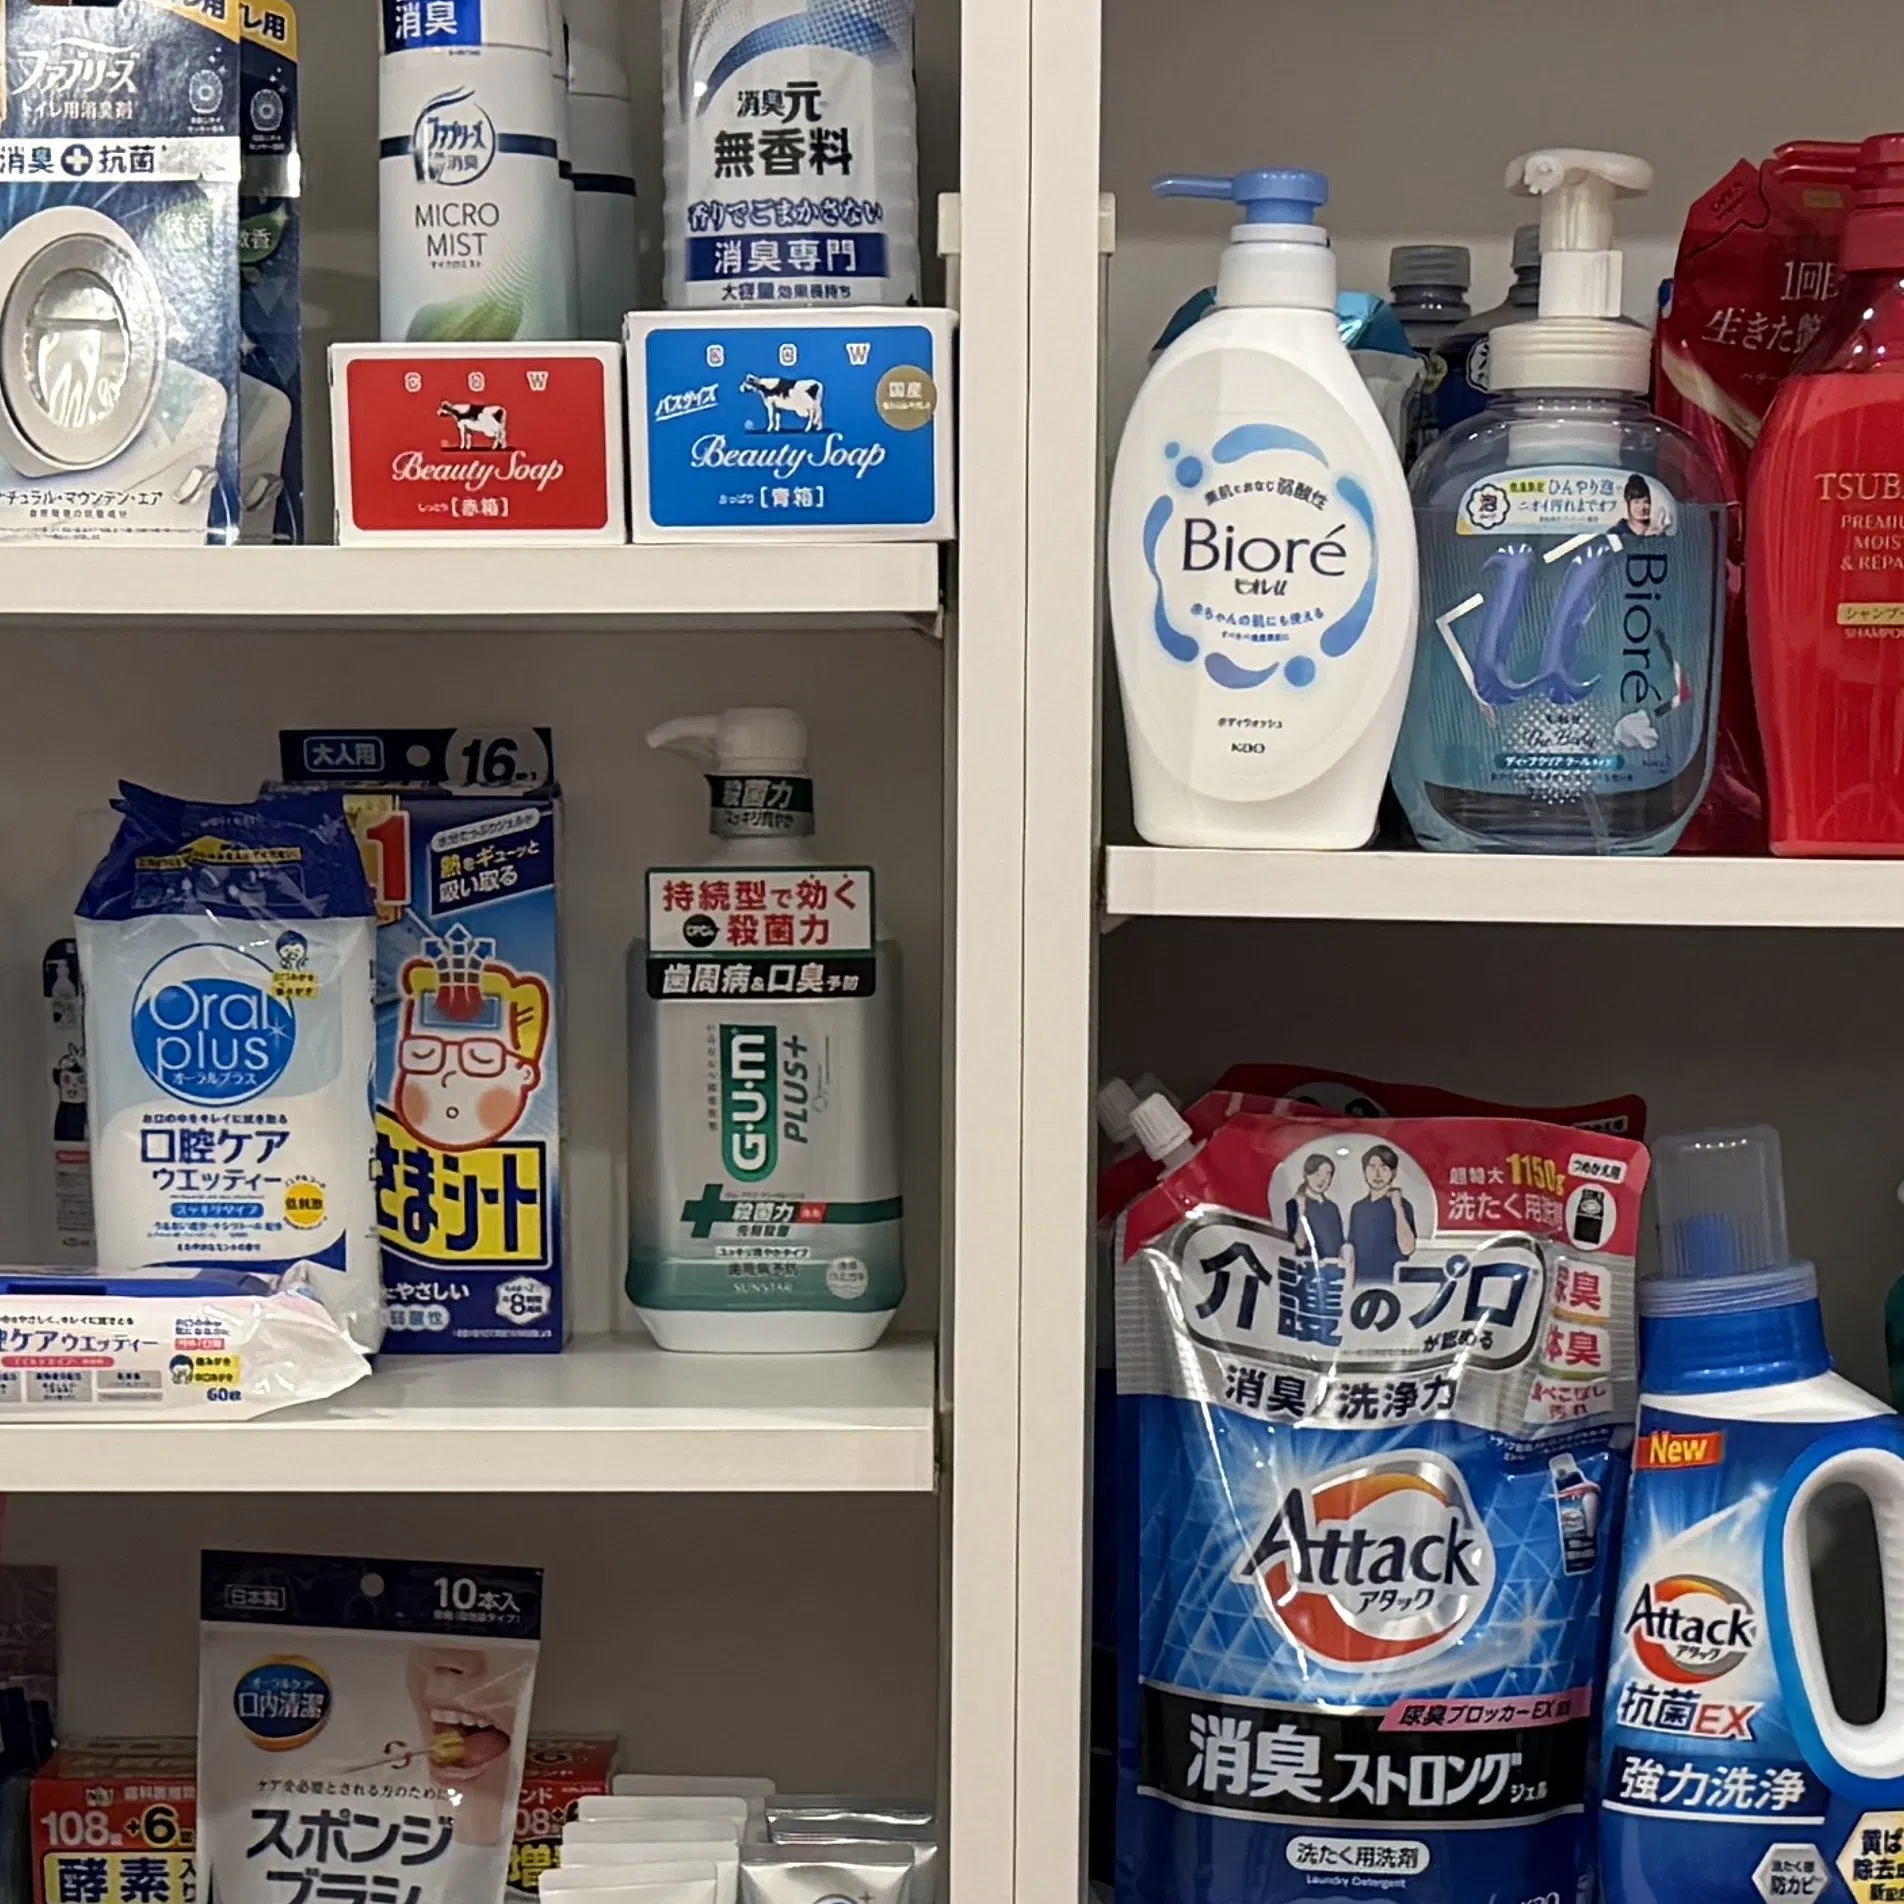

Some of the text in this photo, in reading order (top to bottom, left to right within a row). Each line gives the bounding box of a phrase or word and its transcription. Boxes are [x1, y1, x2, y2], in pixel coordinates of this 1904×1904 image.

[0, 147, 54, 173] 消臭
[97, 147, 156, 173] 抗菌
[714, 128, 853, 178] 無香料
[415, 202, 500, 228] MICRO
[426, 233, 488, 256] MIST
[714, 239, 856, 275] 消臭専門
[391, 450, 563, 495] Beauty Soap
[691, 433, 886, 484] Beauty Soap
[1182, 518, 1347, 577] Bioré
[727, 914, 831, 947] 殺菌力
[156, 1029, 270, 1087] plus
[139, 1127, 292, 1166] 口腔ケア
[1648, 1433, 1708, 1464] New
[1243, 1488, 1480, 1593] Attack
[1625, 1584, 1755, 1647] Attack
[1620, 1755, 1807, 1809] 強力洗浄
[247, 1807, 454, 1863] スポンジ
[1297, 1843, 1419, 1868] 洗たく用洗剤
